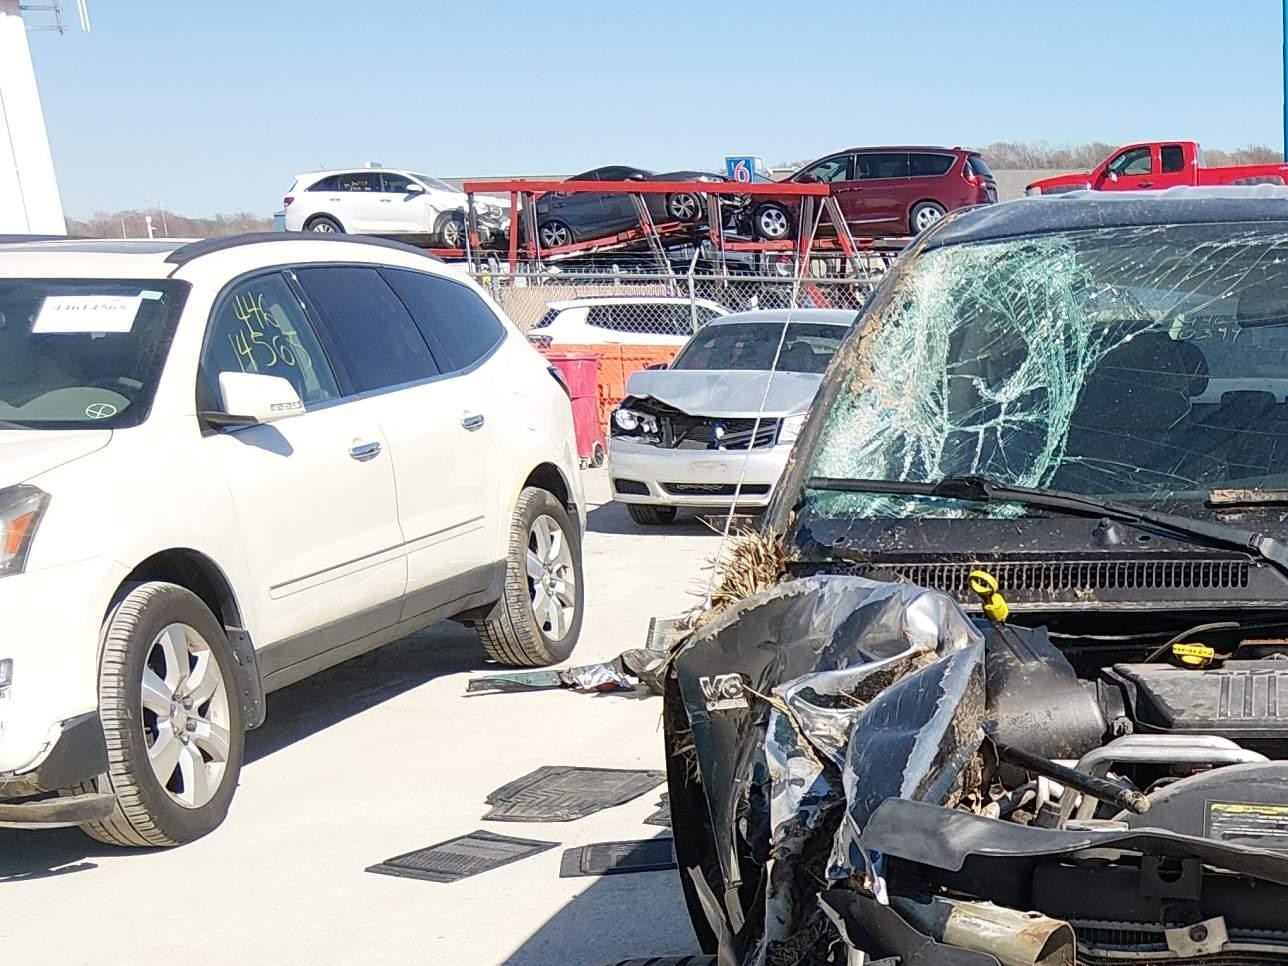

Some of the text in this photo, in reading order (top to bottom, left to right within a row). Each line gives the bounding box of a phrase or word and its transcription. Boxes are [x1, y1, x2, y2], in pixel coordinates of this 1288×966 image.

[734, 160, 750, 183] 6
[233, 291, 281, 334] 446
[699, 673, 743, 700] V6
